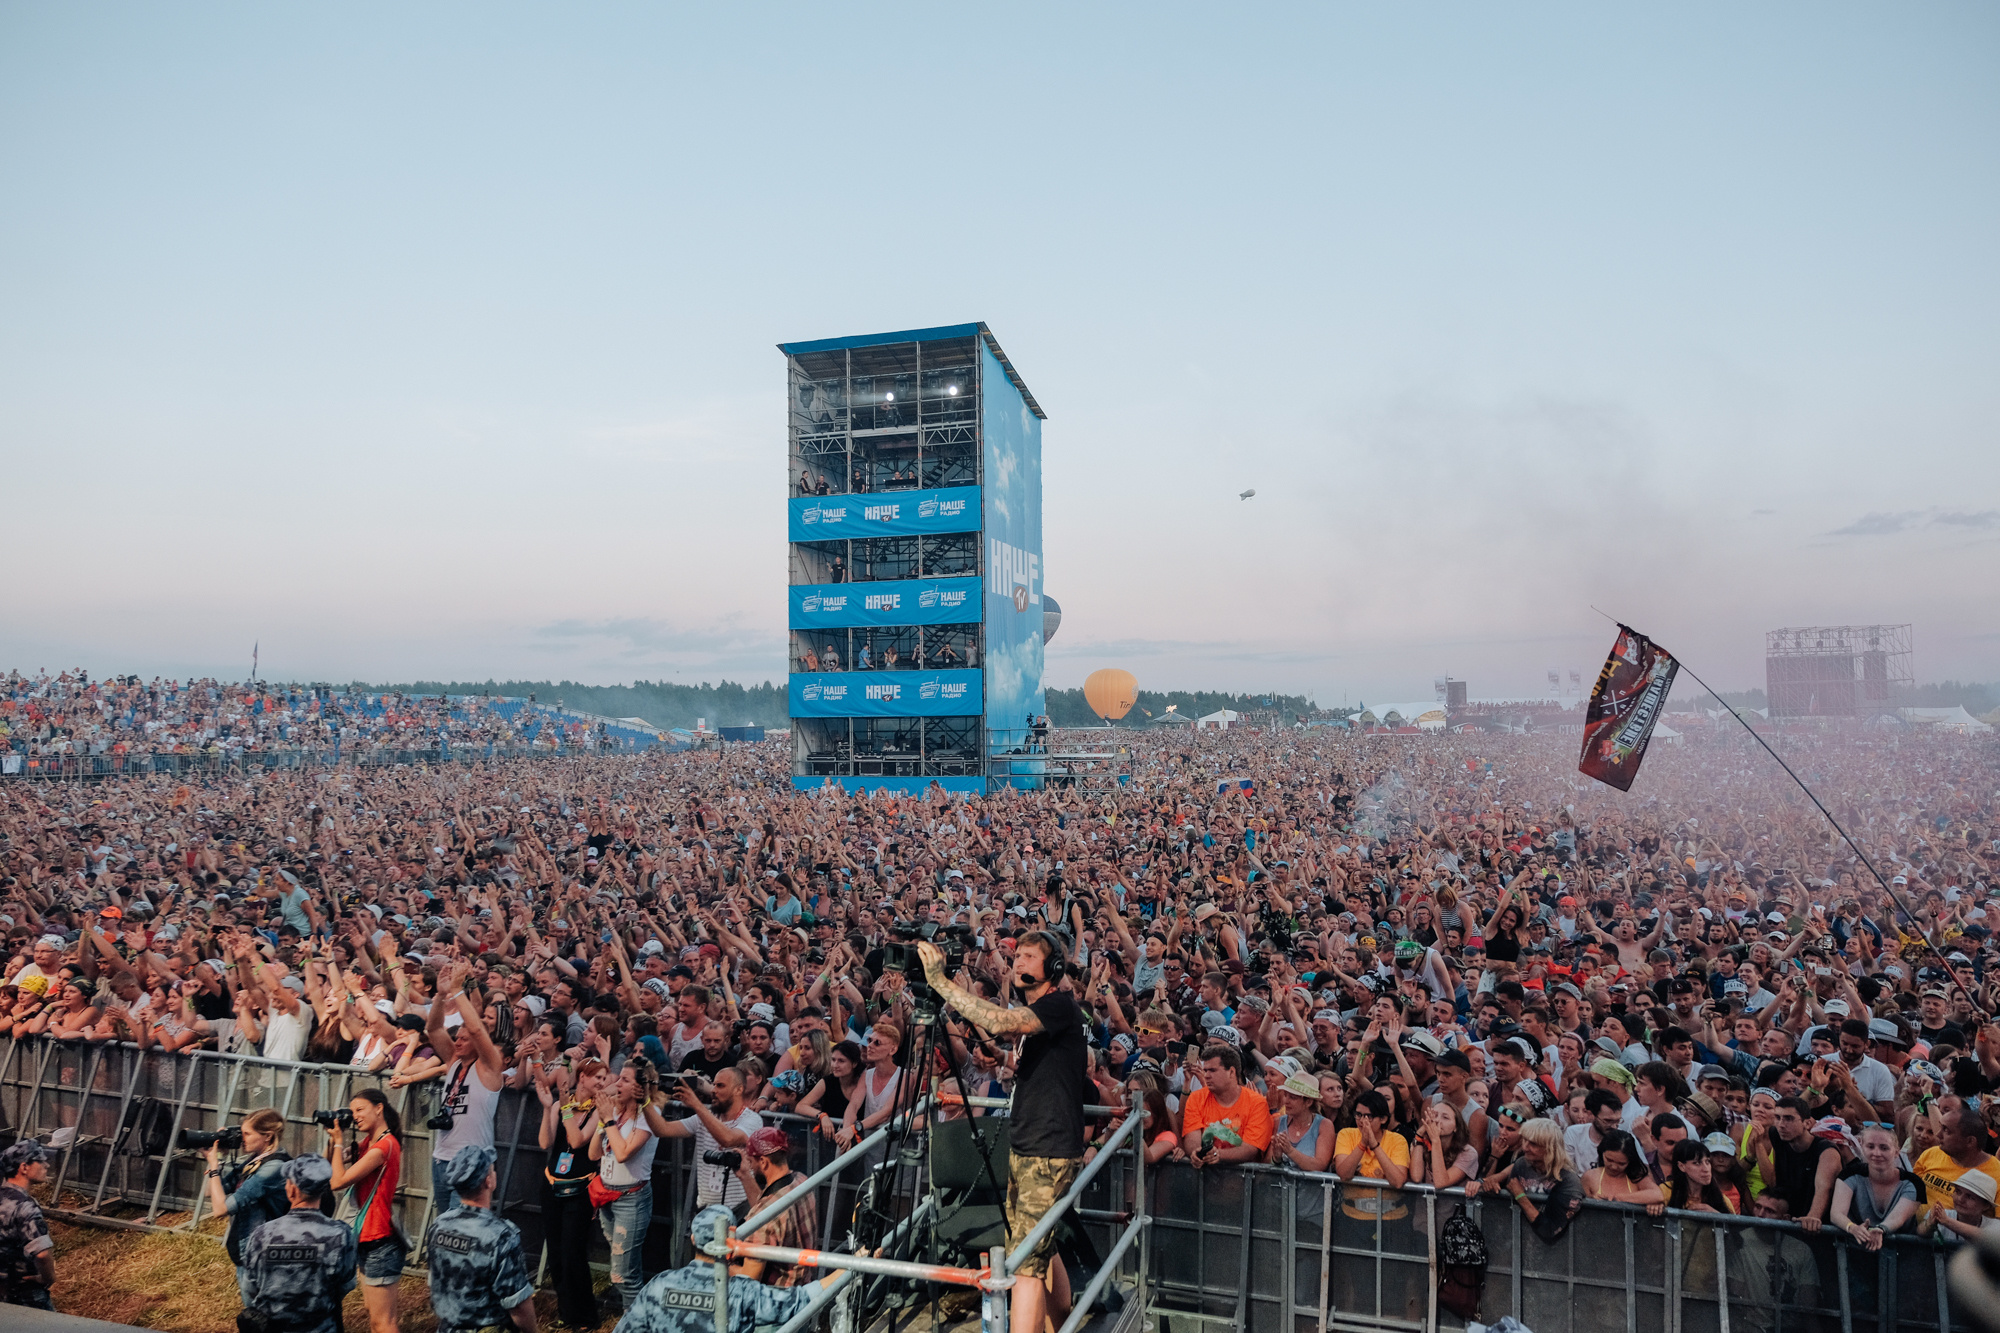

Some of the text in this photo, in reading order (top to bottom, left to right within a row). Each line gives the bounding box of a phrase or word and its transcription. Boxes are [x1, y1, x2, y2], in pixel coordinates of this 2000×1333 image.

[940, 500, 965, 511] НАШЕ
[822, 508, 847, 518] НАШЕ
[865, 504, 900, 520] НАШЕ
[991, 538, 1039, 605] НАШЕ
[823, 596, 847, 606] НАШЕ
[866, 594, 900, 610] НАШЕ
[941, 591, 966, 602] НАШЕ
[824, 686, 847, 696] НАШЕ
[866, 684, 901, 700] НАШЕ
[942, 683, 967, 693] НАШЕ
[437, 1234, 468, 1250] ОМОН
[270, 1250, 314, 1259] ОМОН
[669, 1293, 713, 1308] ОМОН
